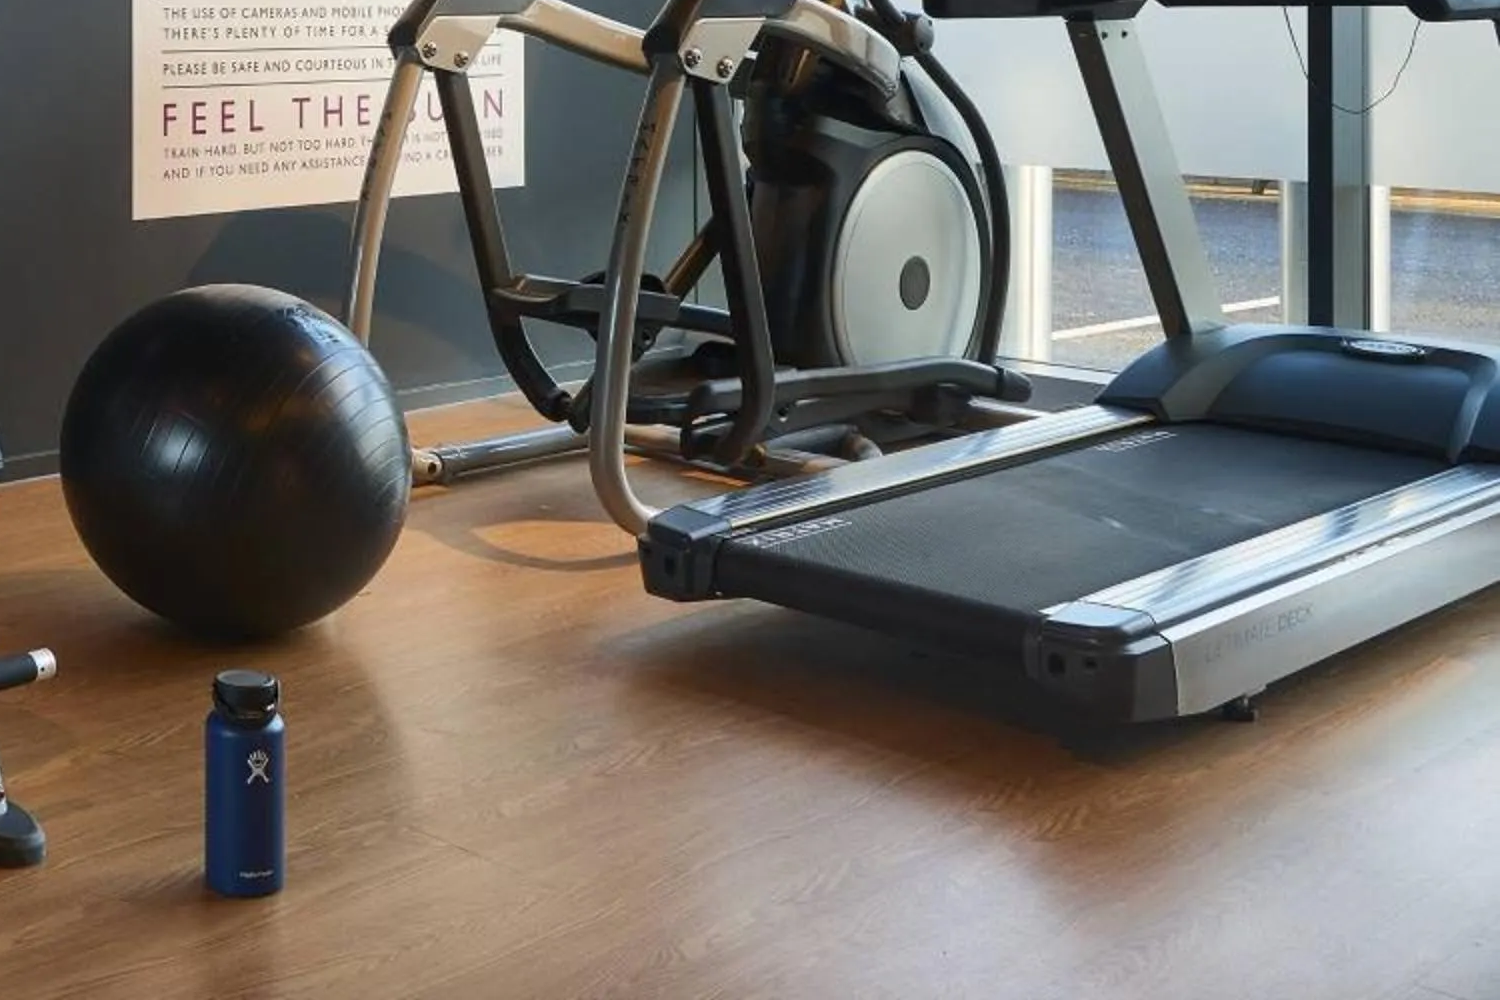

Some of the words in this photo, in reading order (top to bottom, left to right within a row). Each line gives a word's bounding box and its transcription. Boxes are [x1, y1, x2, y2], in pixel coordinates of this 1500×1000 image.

[163, 7, 189, 21] THE
[193, 7, 216, 20] USE
[221, 7, 236, 20] OF
[241, 6, 298, 20] CAMERAS
[300, 6, 326, 19] AND
[331, 6, 372, 19] MOBILE
[377, 6, 404, 19] PHO
[163, 26, 220, 40] THERE'S
[225, 25, 276, 39] PLENTY
[283, 25, 300, 38] OF
[305, 24, 335, 38] TIME
[341, 24, 365, 37] FOR
[369, 24, 377, 37] A
[163, 61, 208, 76] PLEASE
[212, 60, 225, 75] BE
[231, 60, 259, 74] SAFE
[264, 59, 291, 73] AND
[295, 57, 367, 72] COURTEOUS
[371, 56, 382, 70] IN
[481, 53, 501, 66] LIFE
[163, 99, 264, 136] FEEL
[291, 94, 370, 129] THE
[407, 89, 503, 123] UN
[164, 144, 198, 160] TRAIN
[243, 141, 263, 155] BUT
[270, 139, 294, 154] NOT
[297, 137, 320, 152] TOO
[164, 165, 188, 181] AND
[196, 164, 203, 179] IF
[209, 163, 231, 178] YOU
[239, 160, 268, 176] NEED
[273, 158, 295, 173] ANY
[301, 154, 365, 171] ASSISTANCE
